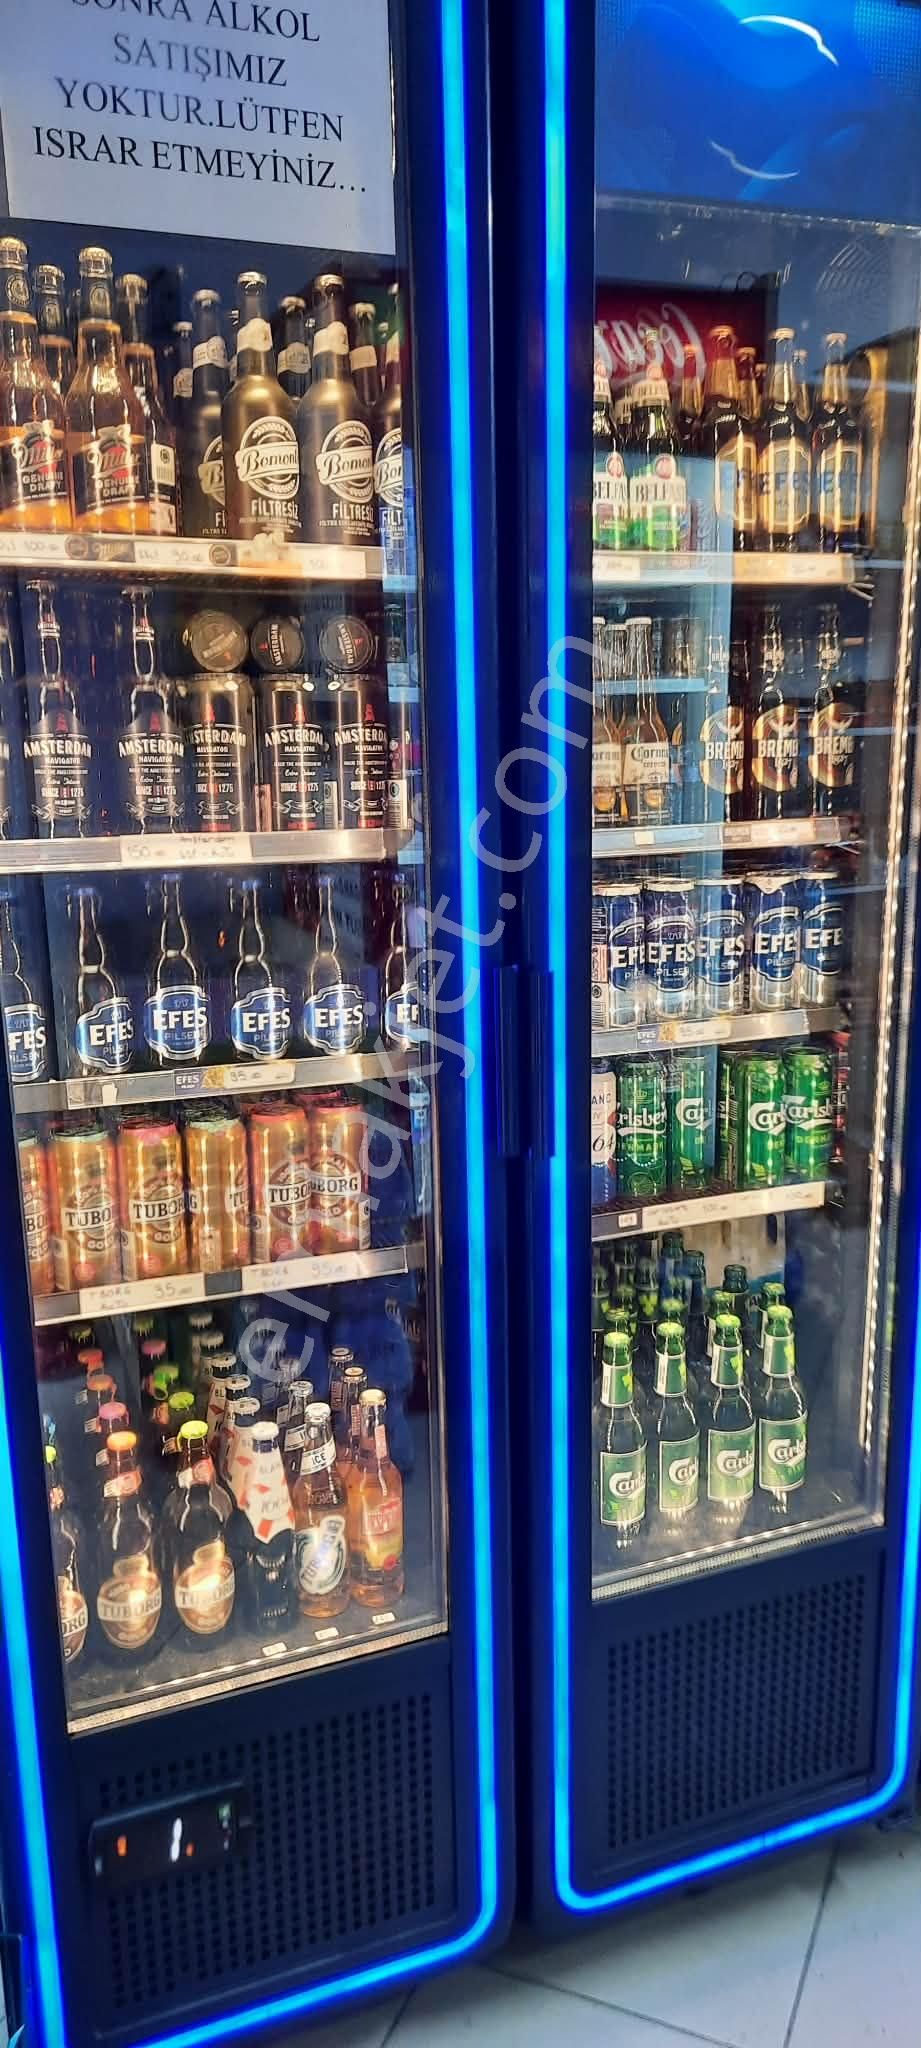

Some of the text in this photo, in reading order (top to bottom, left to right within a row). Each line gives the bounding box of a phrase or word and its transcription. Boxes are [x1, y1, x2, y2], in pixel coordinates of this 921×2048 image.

[207, 0, 321, 42] ALKOL
[113, 32, 288, 87] SATIŞIMIZ
[54, 76, 344, 142] YOKTUR.LÜTFEN
[32, 125, 141, 167] ISRAR
[647, 940, 696, 964] EFES
[152, 1006, 208, 1032] EFES
[242, 1007, 291, 1034] EFES
[314, 1003, 364, 1029] EFES
[89, 1018, 134, 1047] EFES
[175, 1074, 200, 1086] EFES
[312, 1451, 327, 1466] ICE
